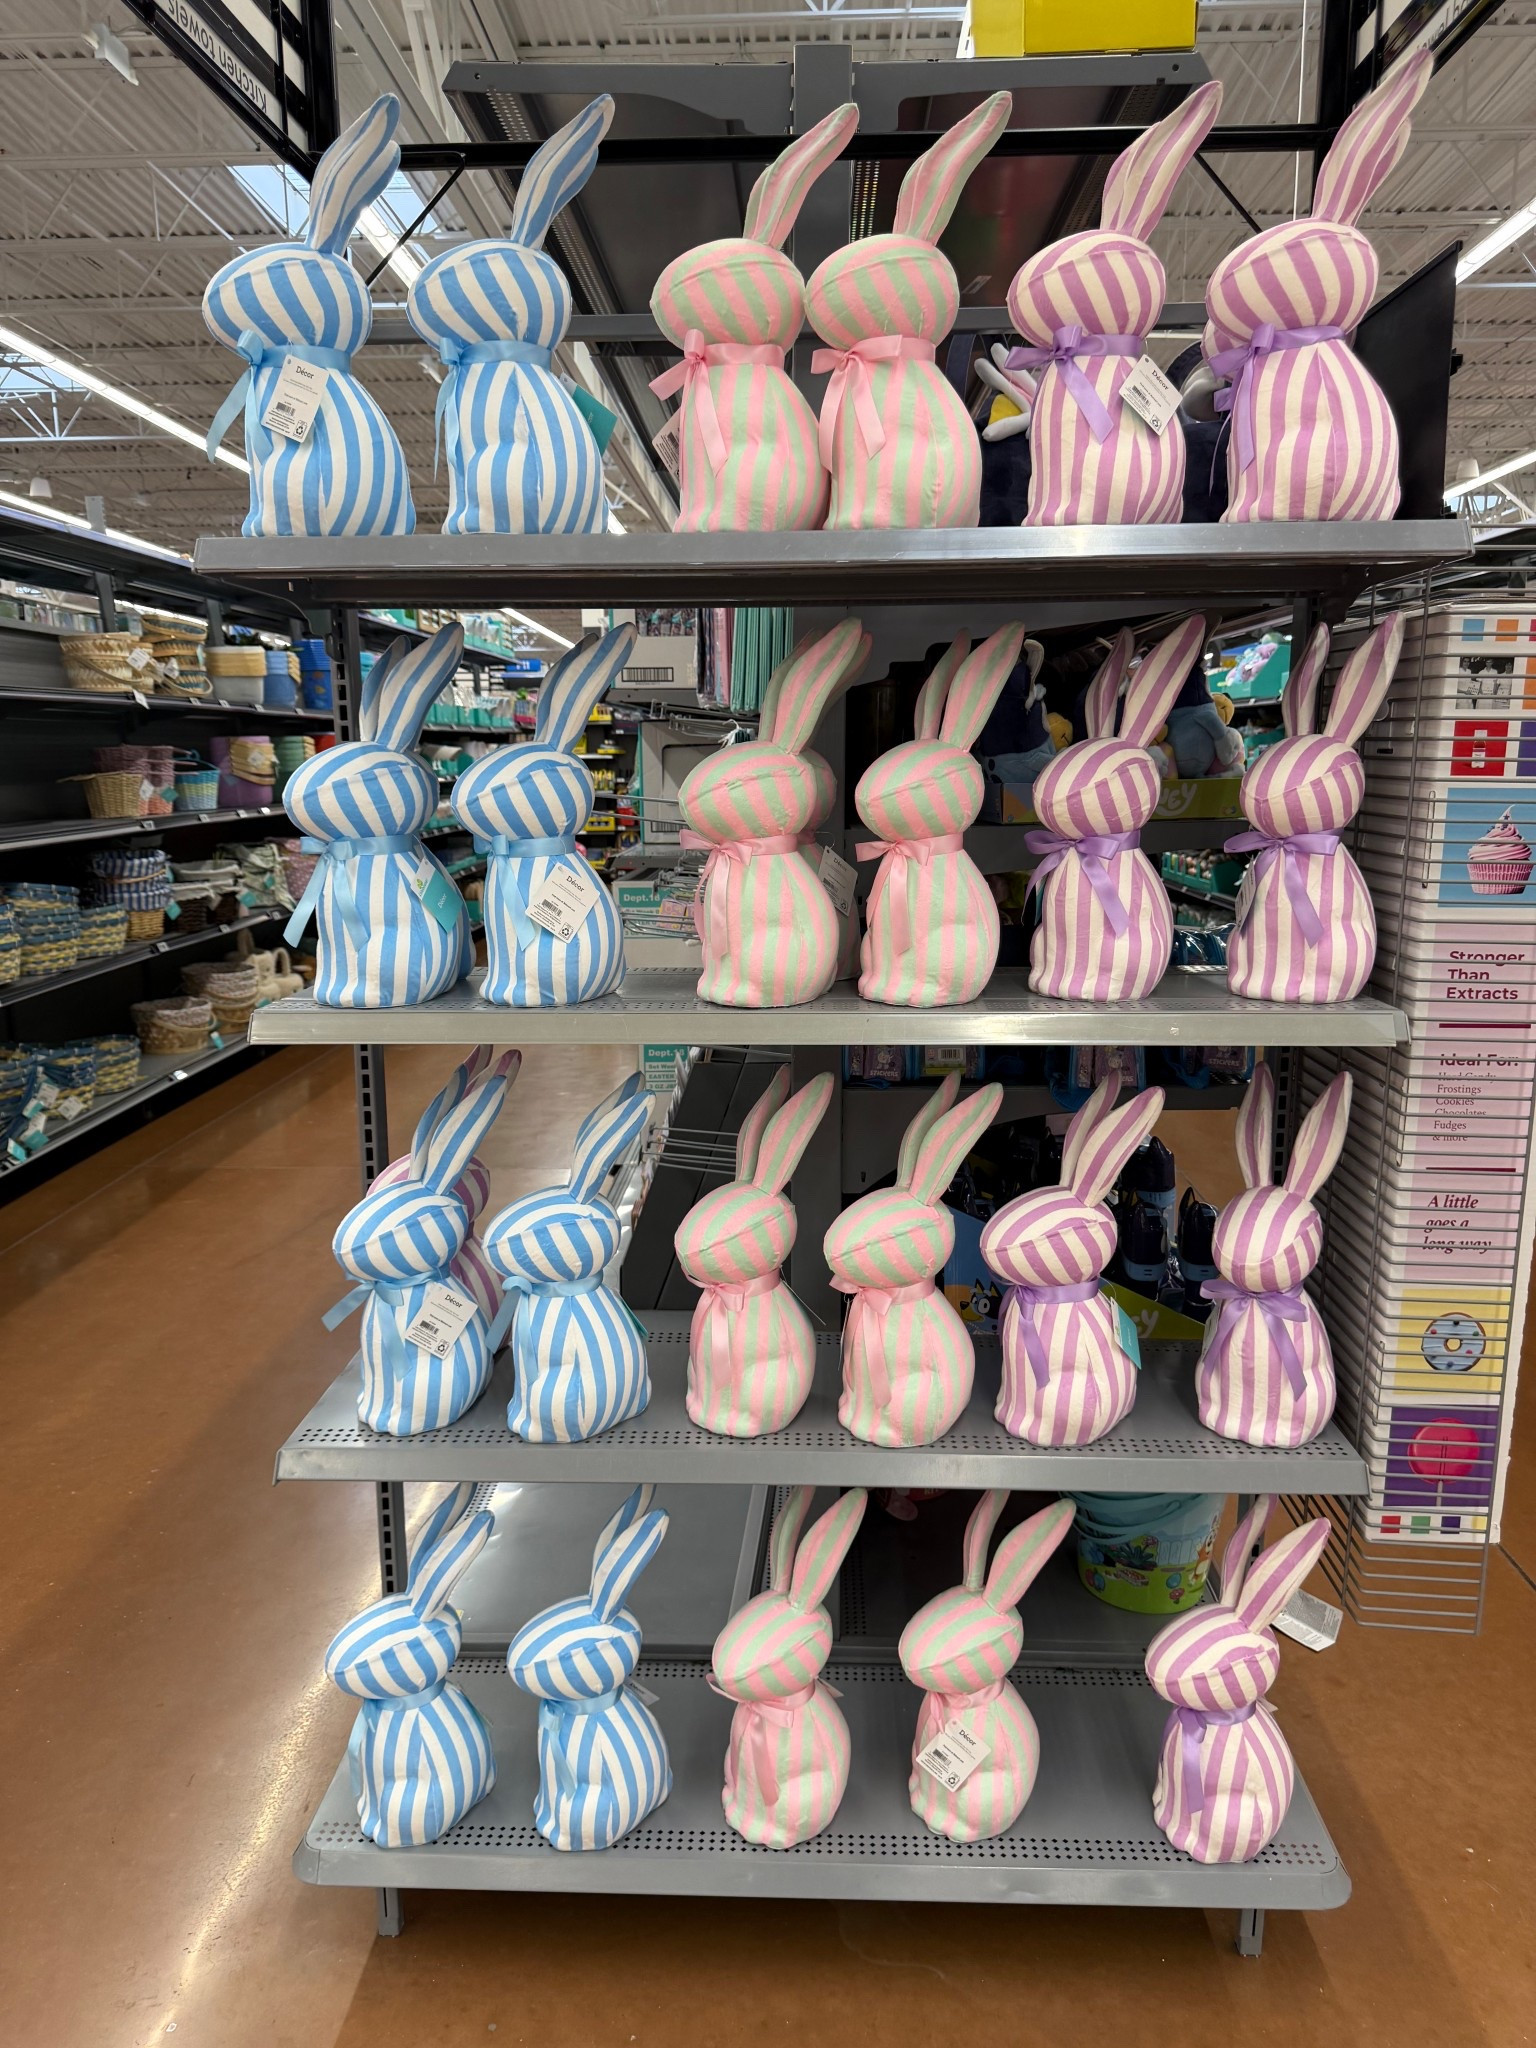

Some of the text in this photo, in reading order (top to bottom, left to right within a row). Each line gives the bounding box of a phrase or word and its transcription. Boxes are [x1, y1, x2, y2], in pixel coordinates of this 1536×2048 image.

[218, 45, 267, 114] Kitchen
[295, 365, 315, 379] Décor
[1151, 369, 1169, 390] Décor
[566, 875, 585, 892] Décor
[1449, 950, 1525, 967] Stronger
[1447, 968, 1490, 981] Than
[1446, 986, 1519, 1000] Extracts
[1437, 1084, 1482, 1096] Frostings
[1435, 1096, 1475, 1106] Cookies
[1433, 1120, 1467, 1132] Fudges
[1427, 1194, 1479, 1209] A little
[444, 1294, 463, 1308] Décor
[958, 1729, 977, 1746] Décor
